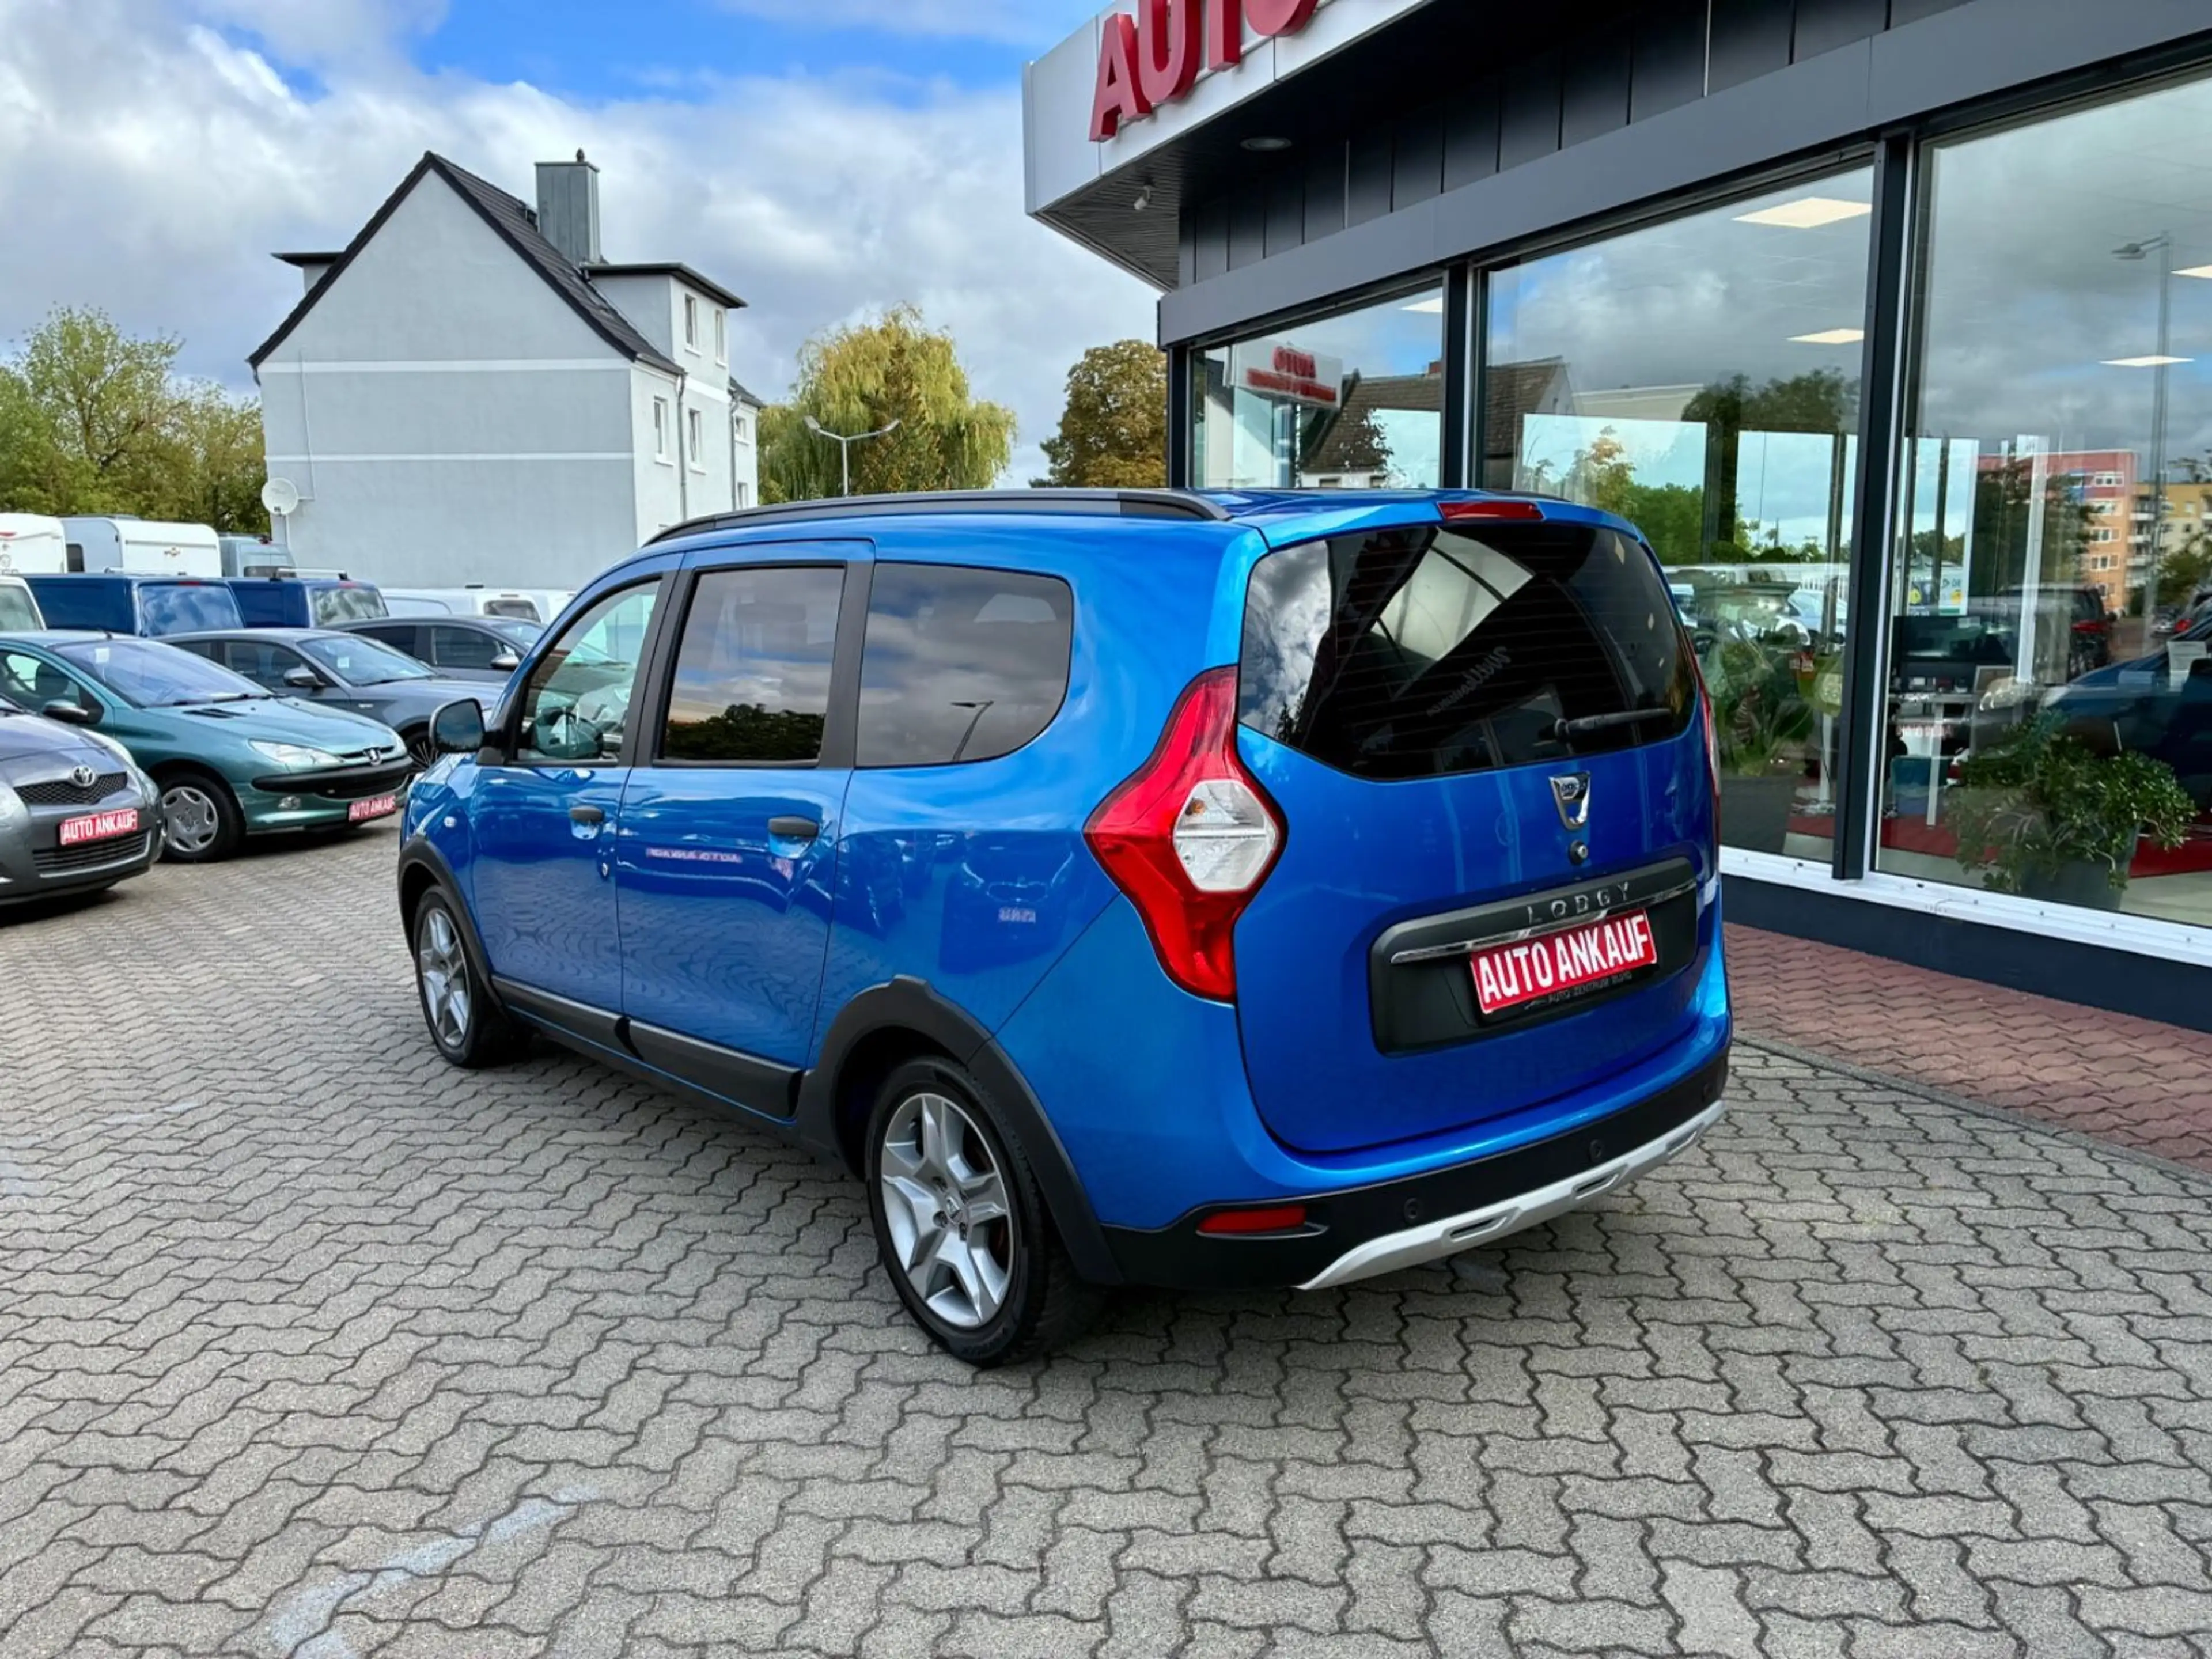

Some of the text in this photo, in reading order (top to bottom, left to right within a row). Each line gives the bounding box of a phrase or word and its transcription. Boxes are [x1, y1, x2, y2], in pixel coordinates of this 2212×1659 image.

[1089, 0, 1318, 141] AU
[63, 810, 137, 839] AUTO ANKAUF
[1527, 881, 1629, 924] LODGY
[1478, 915, 1648, 1003] AUTO ANKAUF
